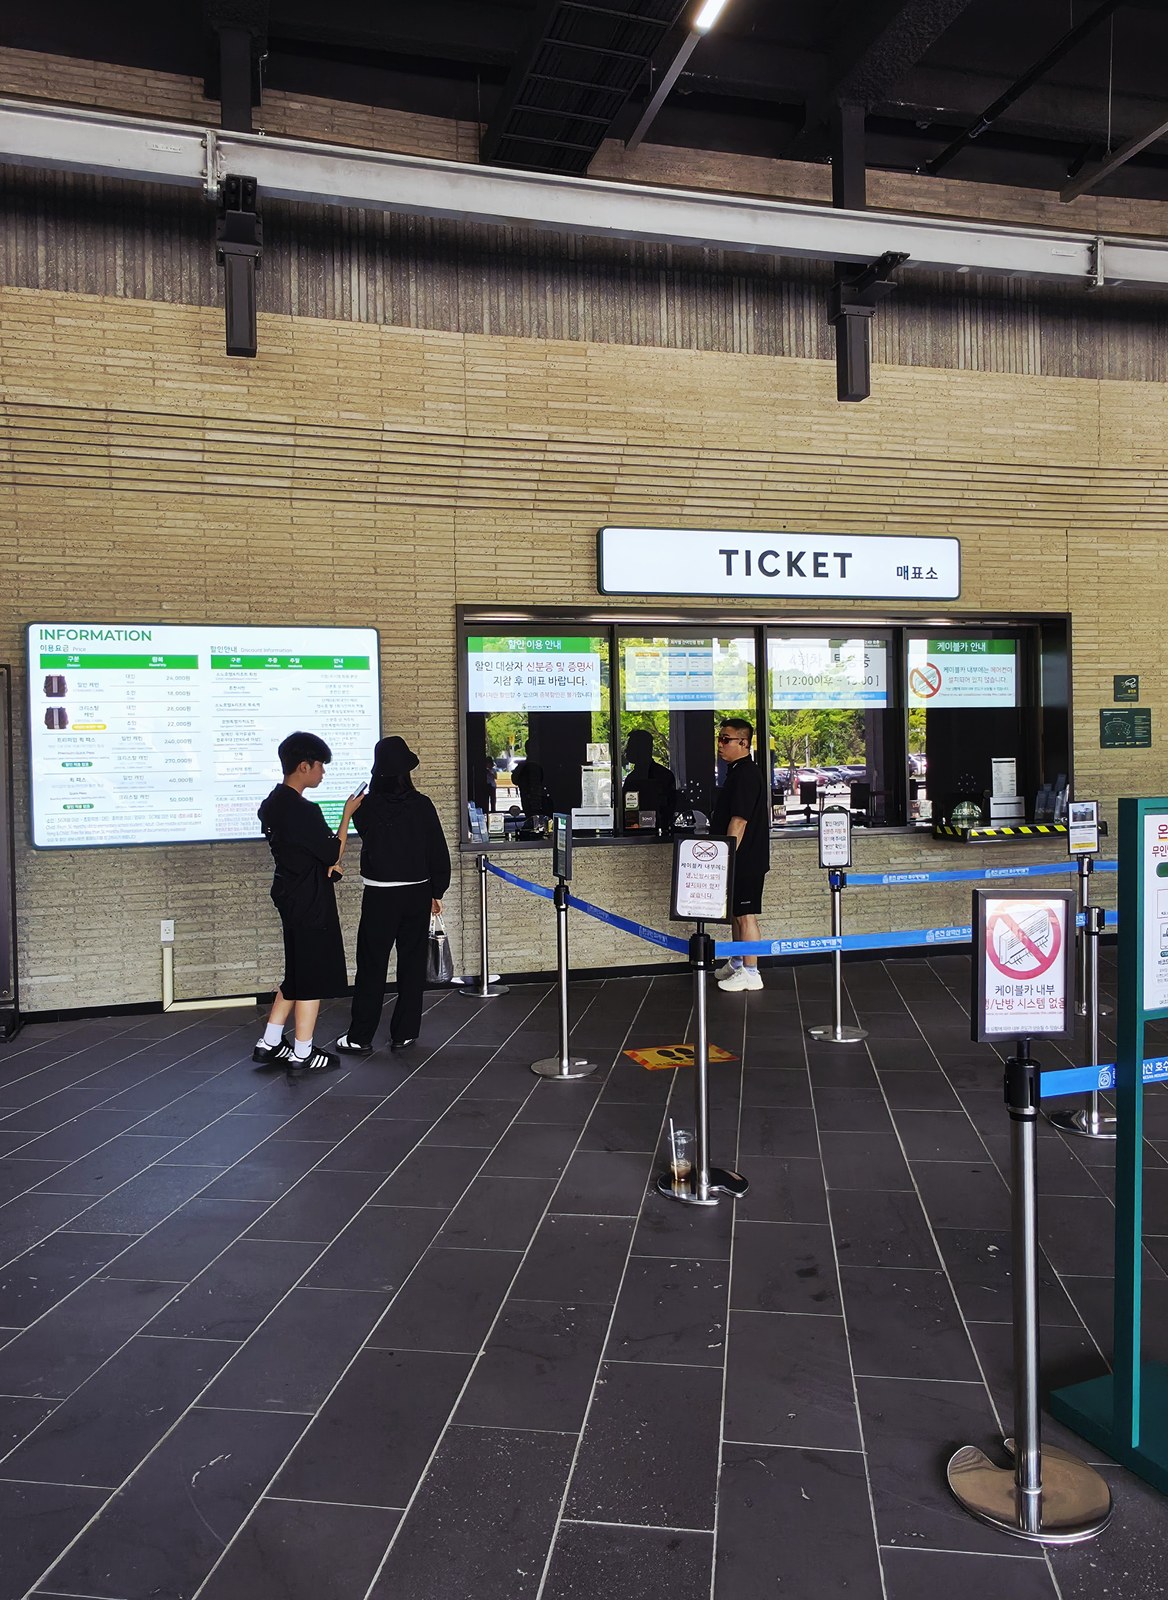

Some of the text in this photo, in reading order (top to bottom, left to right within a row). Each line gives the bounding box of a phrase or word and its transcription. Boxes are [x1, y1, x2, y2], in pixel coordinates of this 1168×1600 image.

[718, 549, 853, 579] TICKET
[896, 565, 938, 581] 매표소
[40, 629, 152, 642] INFORMATION
[40, 644, 69, 653] 이용요금
[210, 646, 238, 654] 할인안내
[508, 640, 562, 650] 할인 이용 안내
[937, 642, 986, 652] 케이블카 안내
[475, 661, 594, 672] 할인 대상자 신분증 및 증명서
[514, 676, 524, 686] 후
[527, 676, 546, 686] 매표
[548, 676, 588, 686] 바랍니다.
[995, 984, 1056, 996] 케이블카 내부
[1018, 998, 1046, 1010] 시스템
